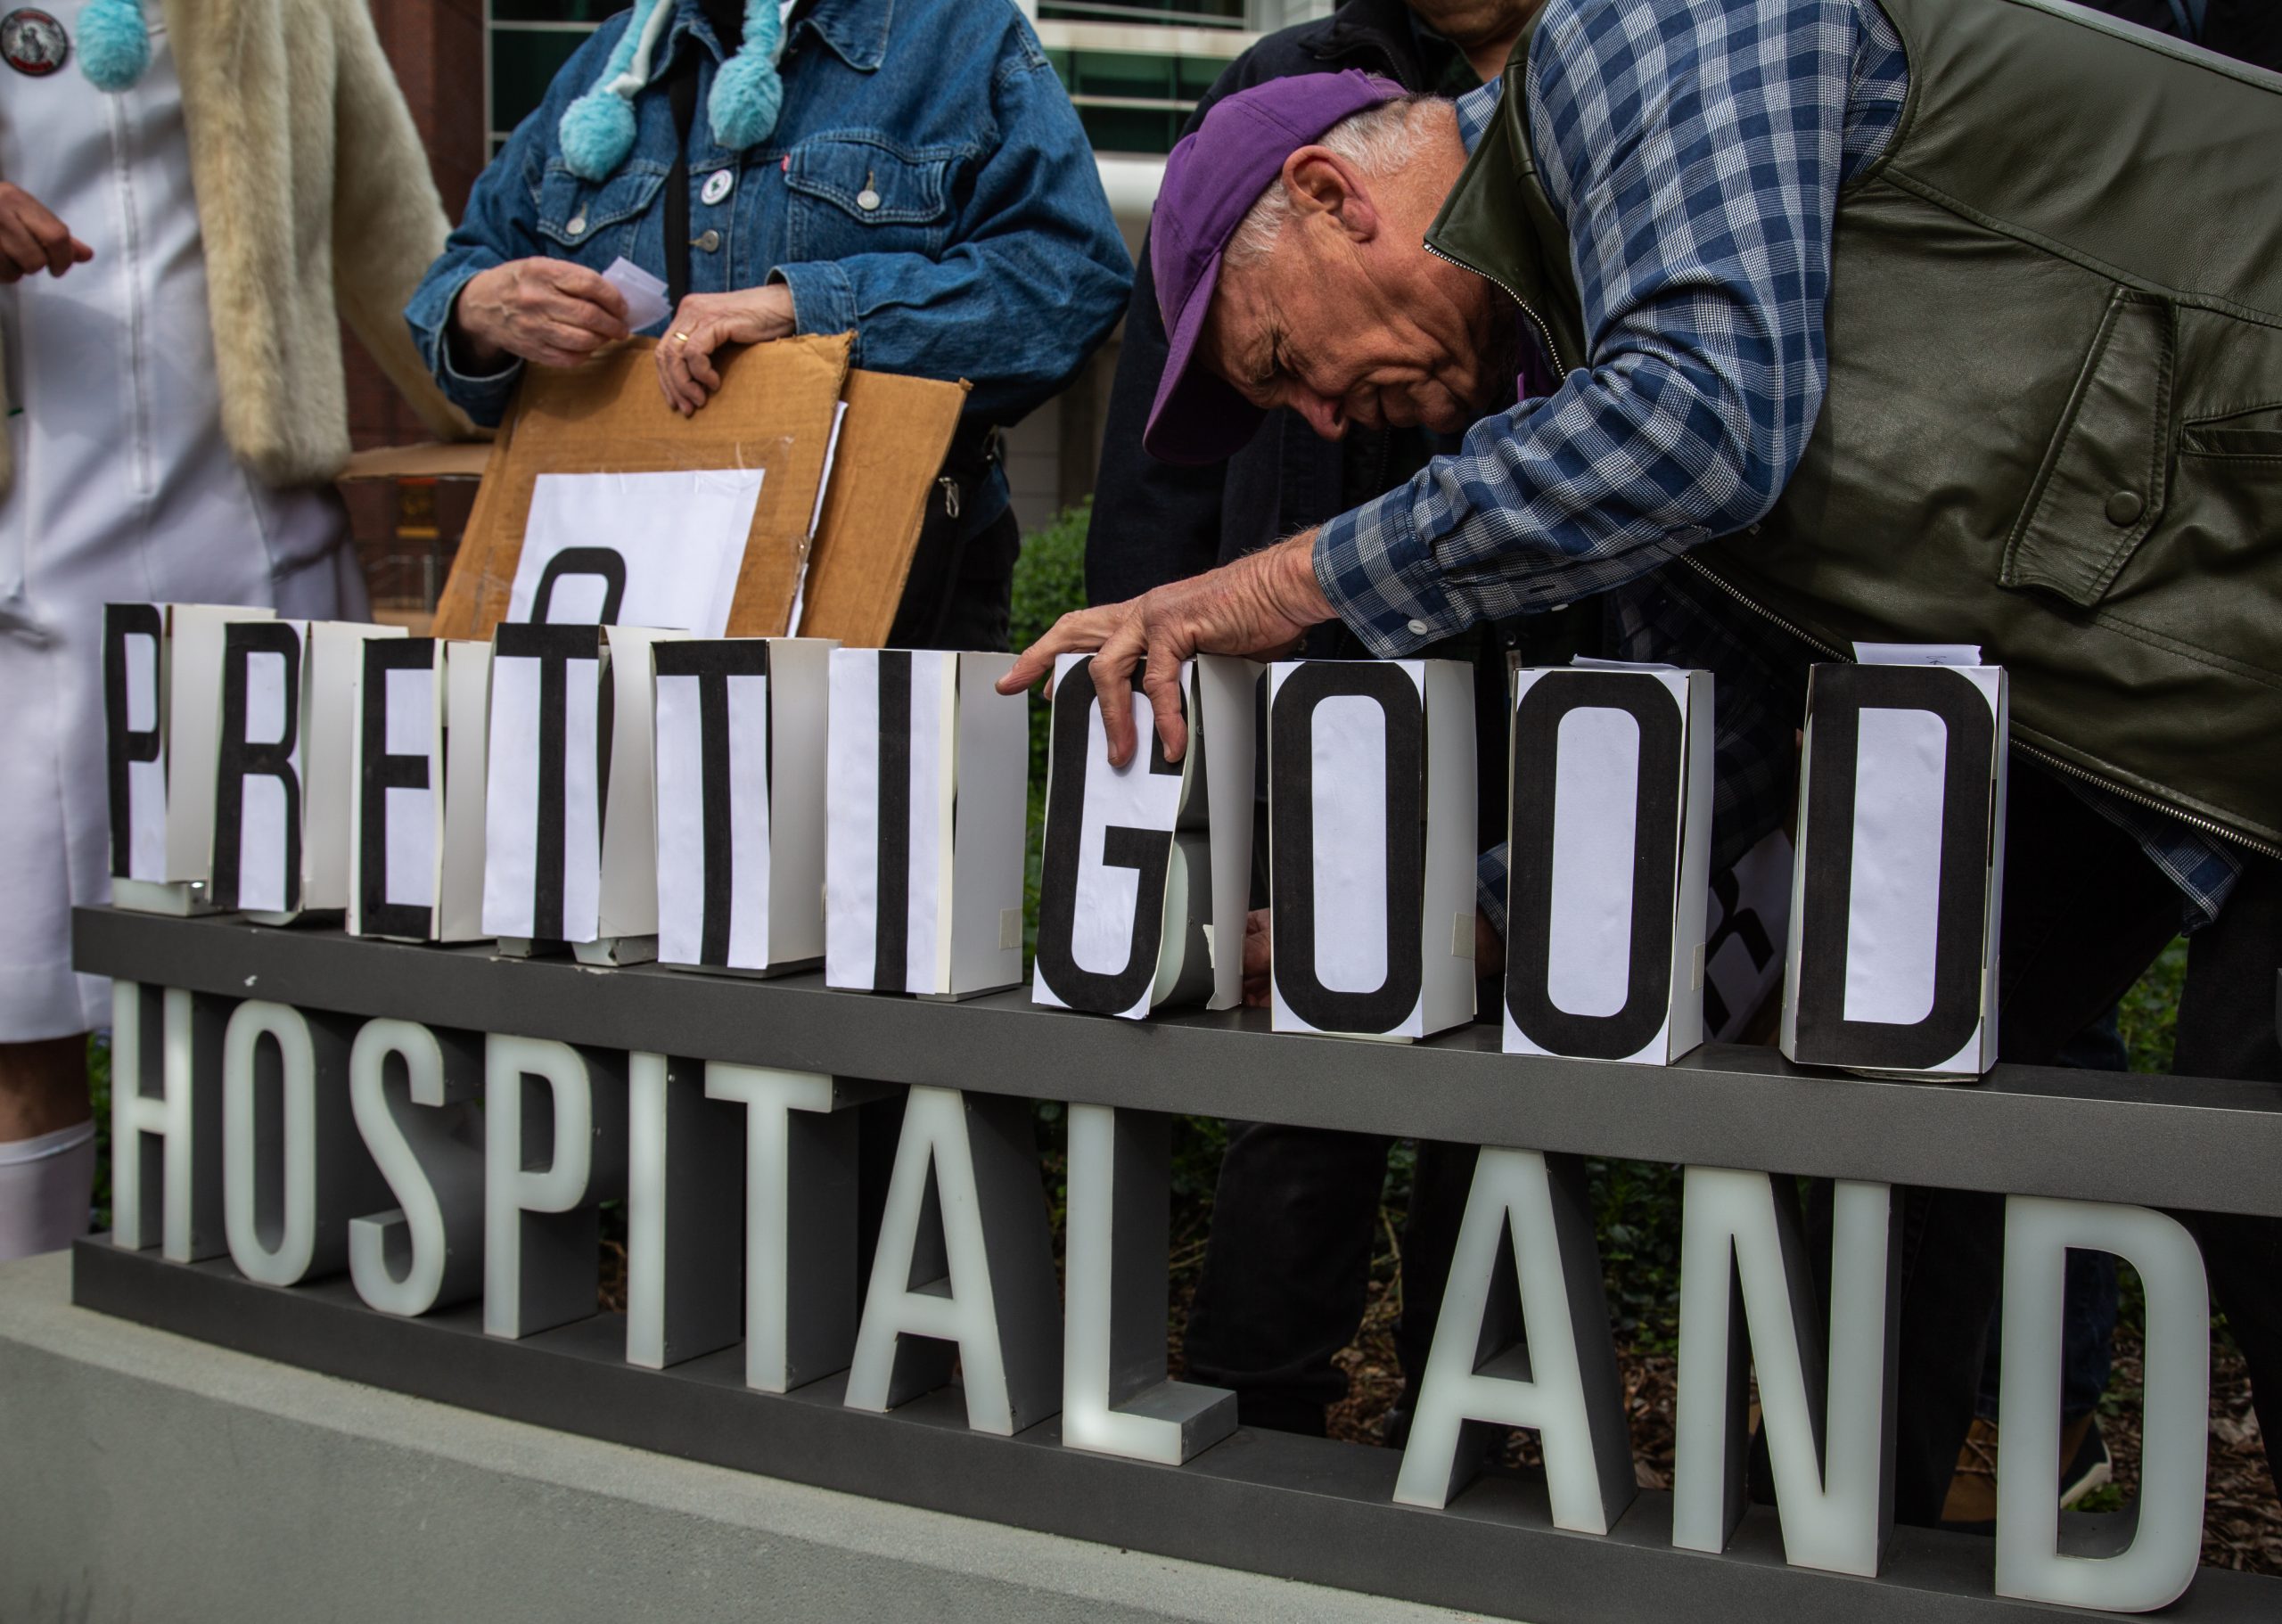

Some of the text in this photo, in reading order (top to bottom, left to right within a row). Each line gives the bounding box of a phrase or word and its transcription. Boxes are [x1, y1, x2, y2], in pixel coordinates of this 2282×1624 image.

[104, 603, 913, 993] PRETTI
[1035, 655, 1996, 1070] GOOD
[111, 979, 2211, 1612] HOSPITAL AND
